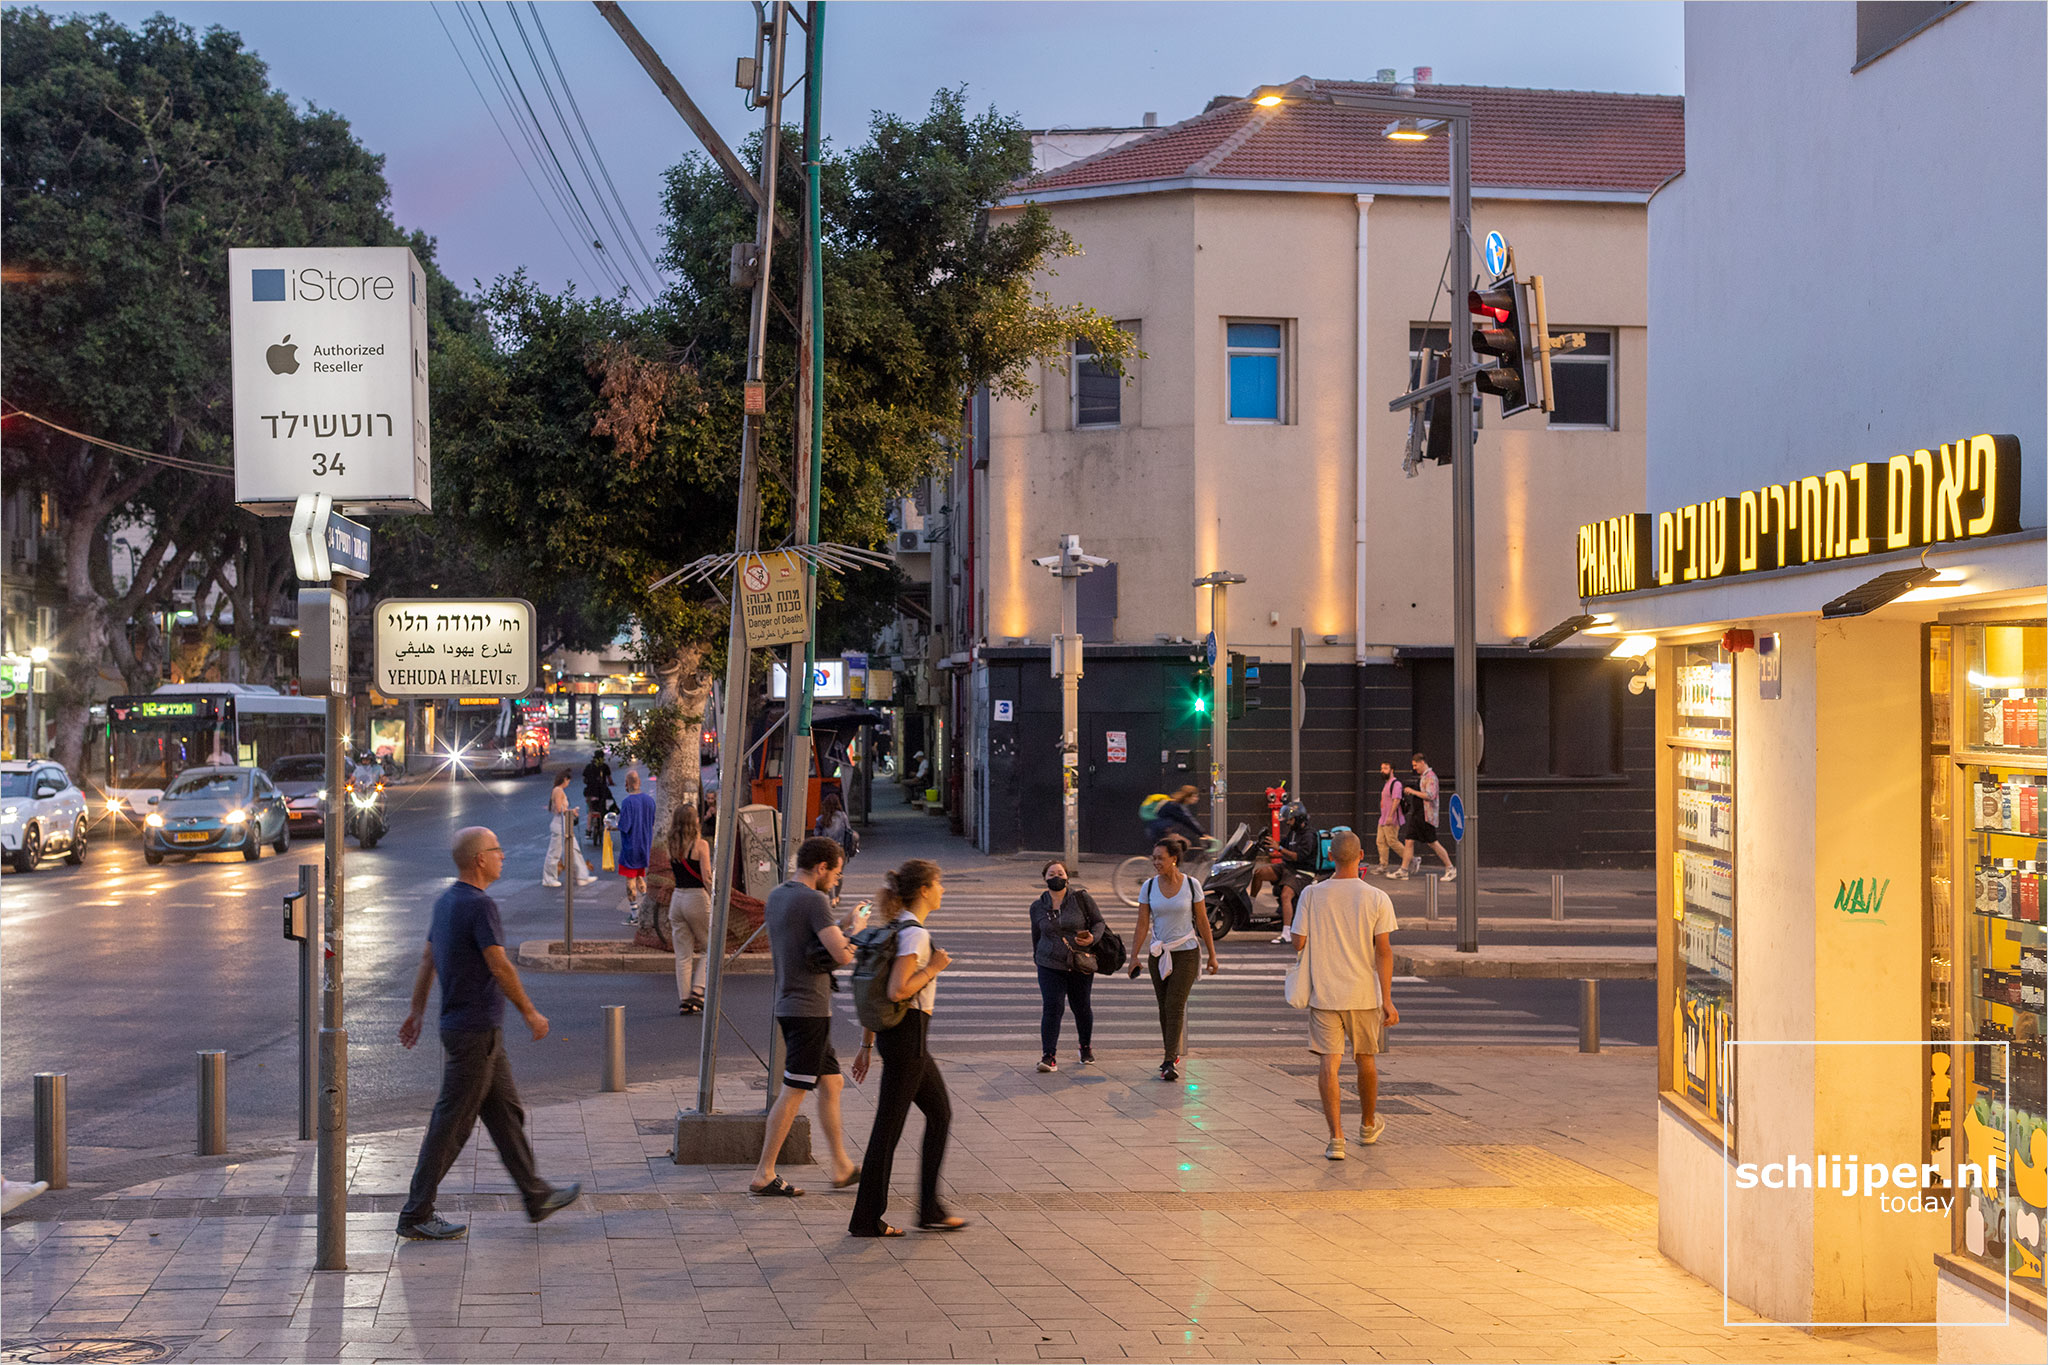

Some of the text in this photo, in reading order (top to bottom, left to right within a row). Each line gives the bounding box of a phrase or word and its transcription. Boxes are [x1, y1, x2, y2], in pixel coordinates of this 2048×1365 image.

[291, 268, 394, 301] iStore
[313, 344, 384, 356] Authorized
[313, 361, 363, 373] Reseller
[261, 411, 393, 439] רוטשילד
[312, 453, 346, 476] 34
[1658, 434, 1997, 586] פארם במחירים טובים
[1579, 513, 1636, 598] PHARM
[746, 589, 800, 605] מתח גבוה!
[747, 600, 801, 616] סכנת מוות!
[388, 611, 428, 632] הלוי
[436, 614, 491, 632] יהודה
[748, 614, 803, 628] Danger of Death!
[443, 643, 475, 658] يهودا
[481, 643, 513, 658] شارع
[388, 669, 520, 685] YEHUDA HALEVI ST.
[1761, 656, 1779, 681] 130
